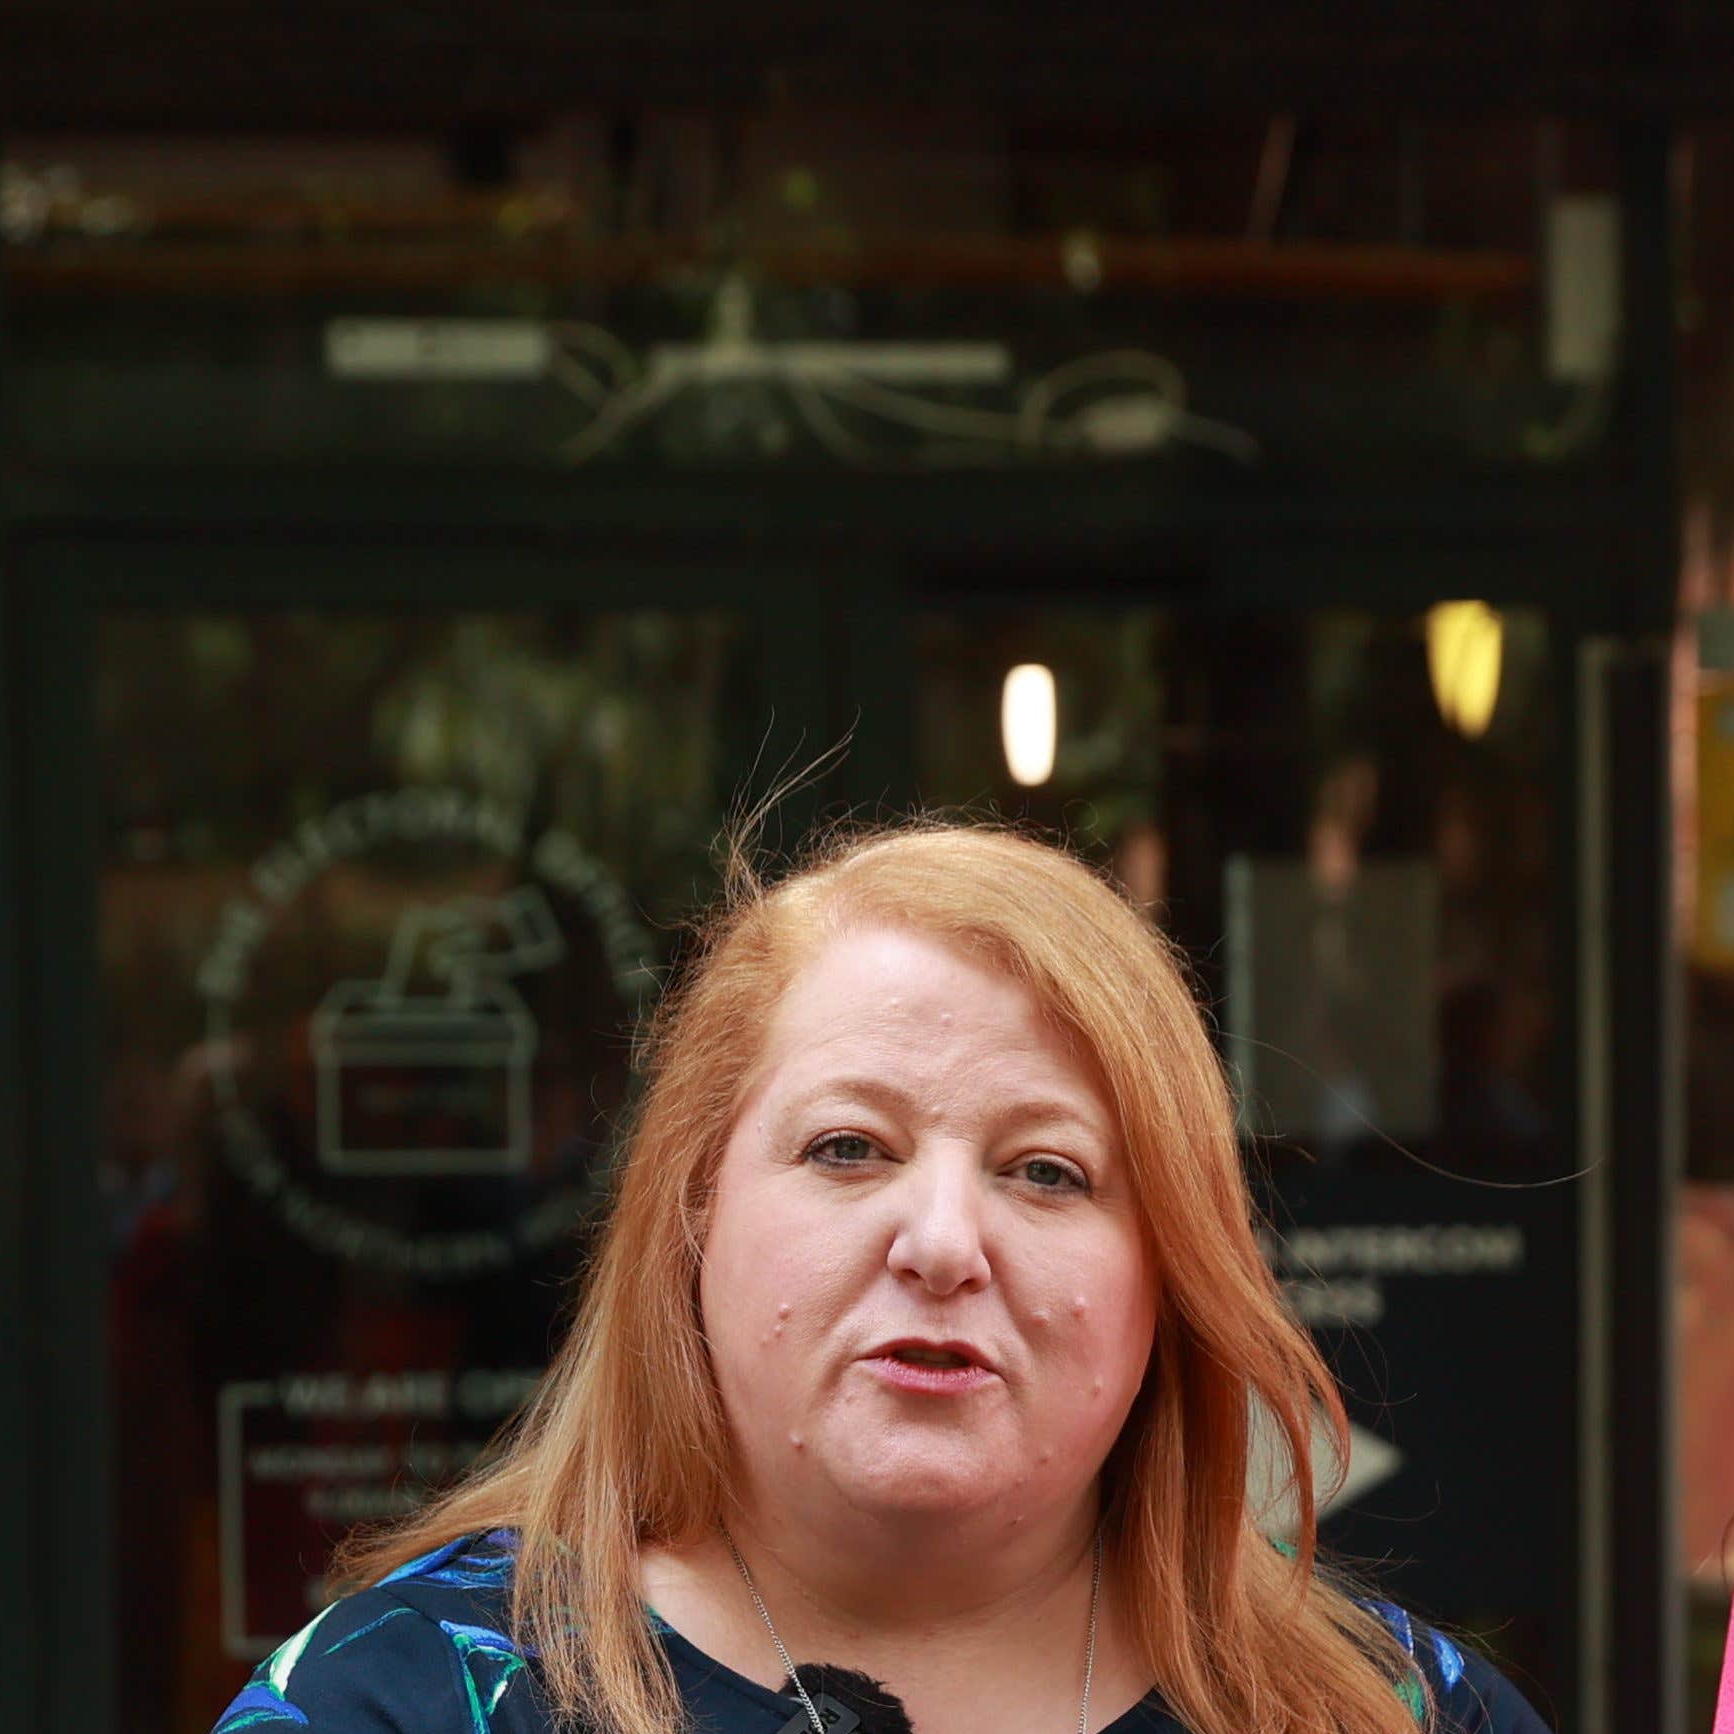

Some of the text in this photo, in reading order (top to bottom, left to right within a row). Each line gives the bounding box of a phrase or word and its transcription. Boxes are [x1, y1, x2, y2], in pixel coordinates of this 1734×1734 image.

[253, 785, 523, 904] ELECTORAL
[1288, 1225, 1522, 1273] INTERCOM
[284, 1371, 348, 1415] WE
[364, 1370, 447, 1415] ARE
